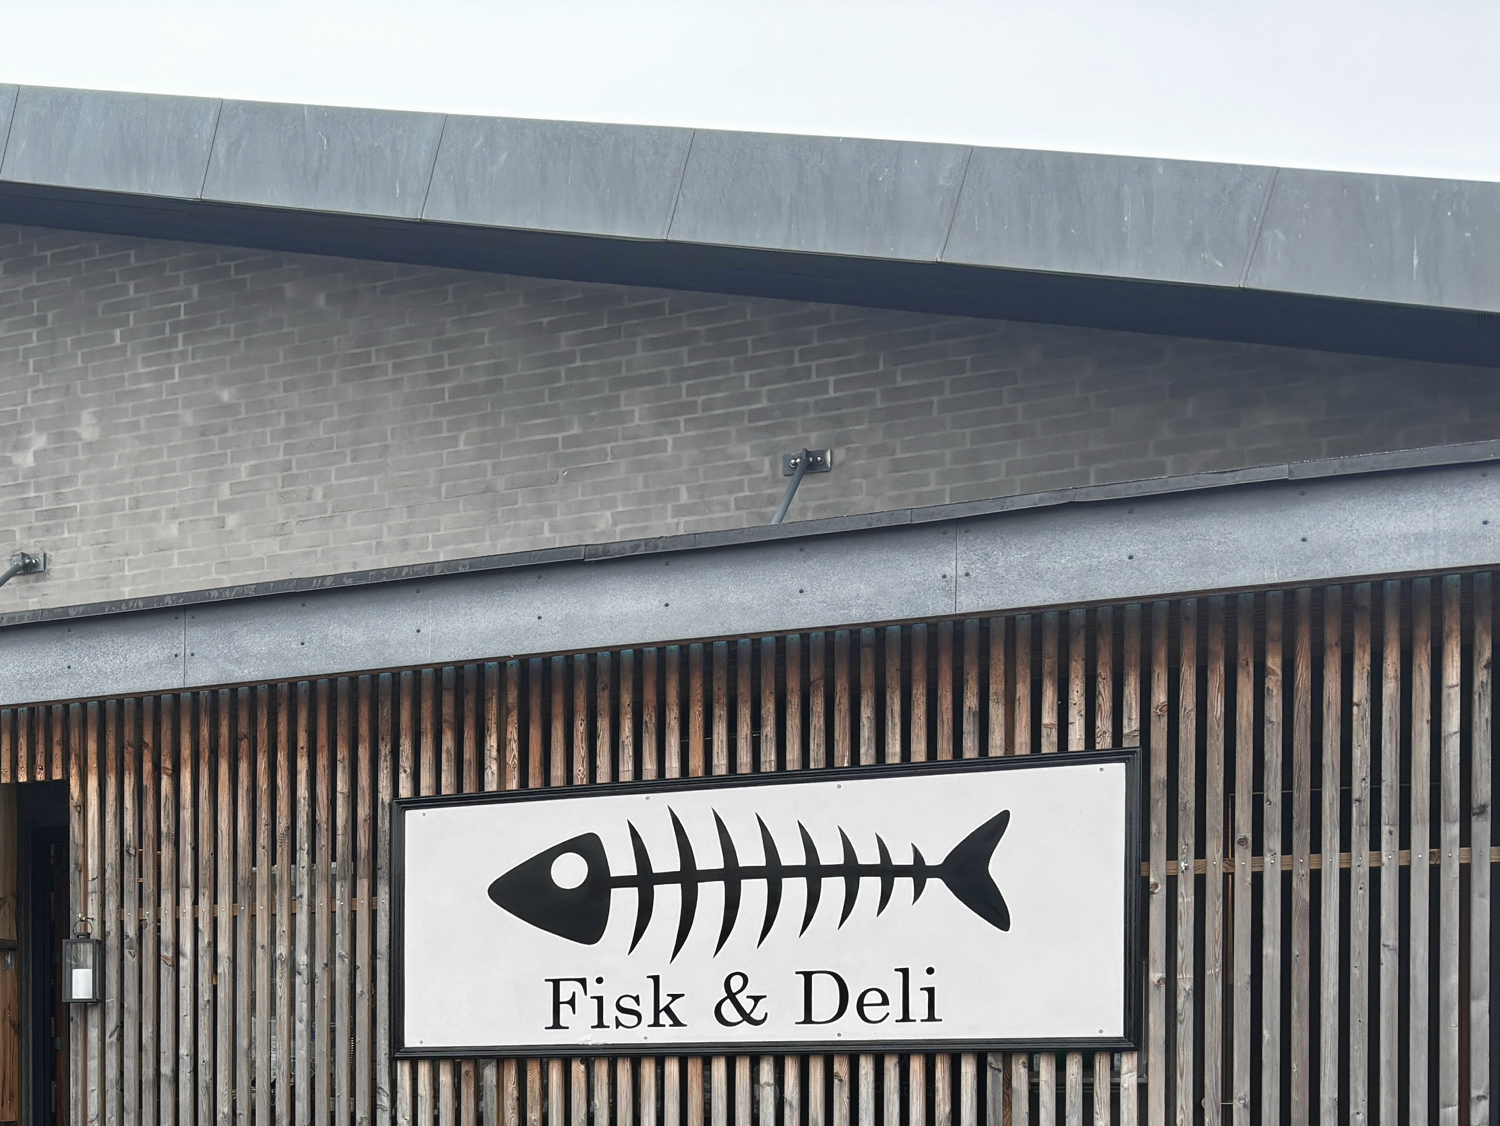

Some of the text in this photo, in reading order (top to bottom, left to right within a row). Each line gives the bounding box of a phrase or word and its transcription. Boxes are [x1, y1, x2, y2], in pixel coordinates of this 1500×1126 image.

[544, 967, 943, 1031] Fisk & Deli
